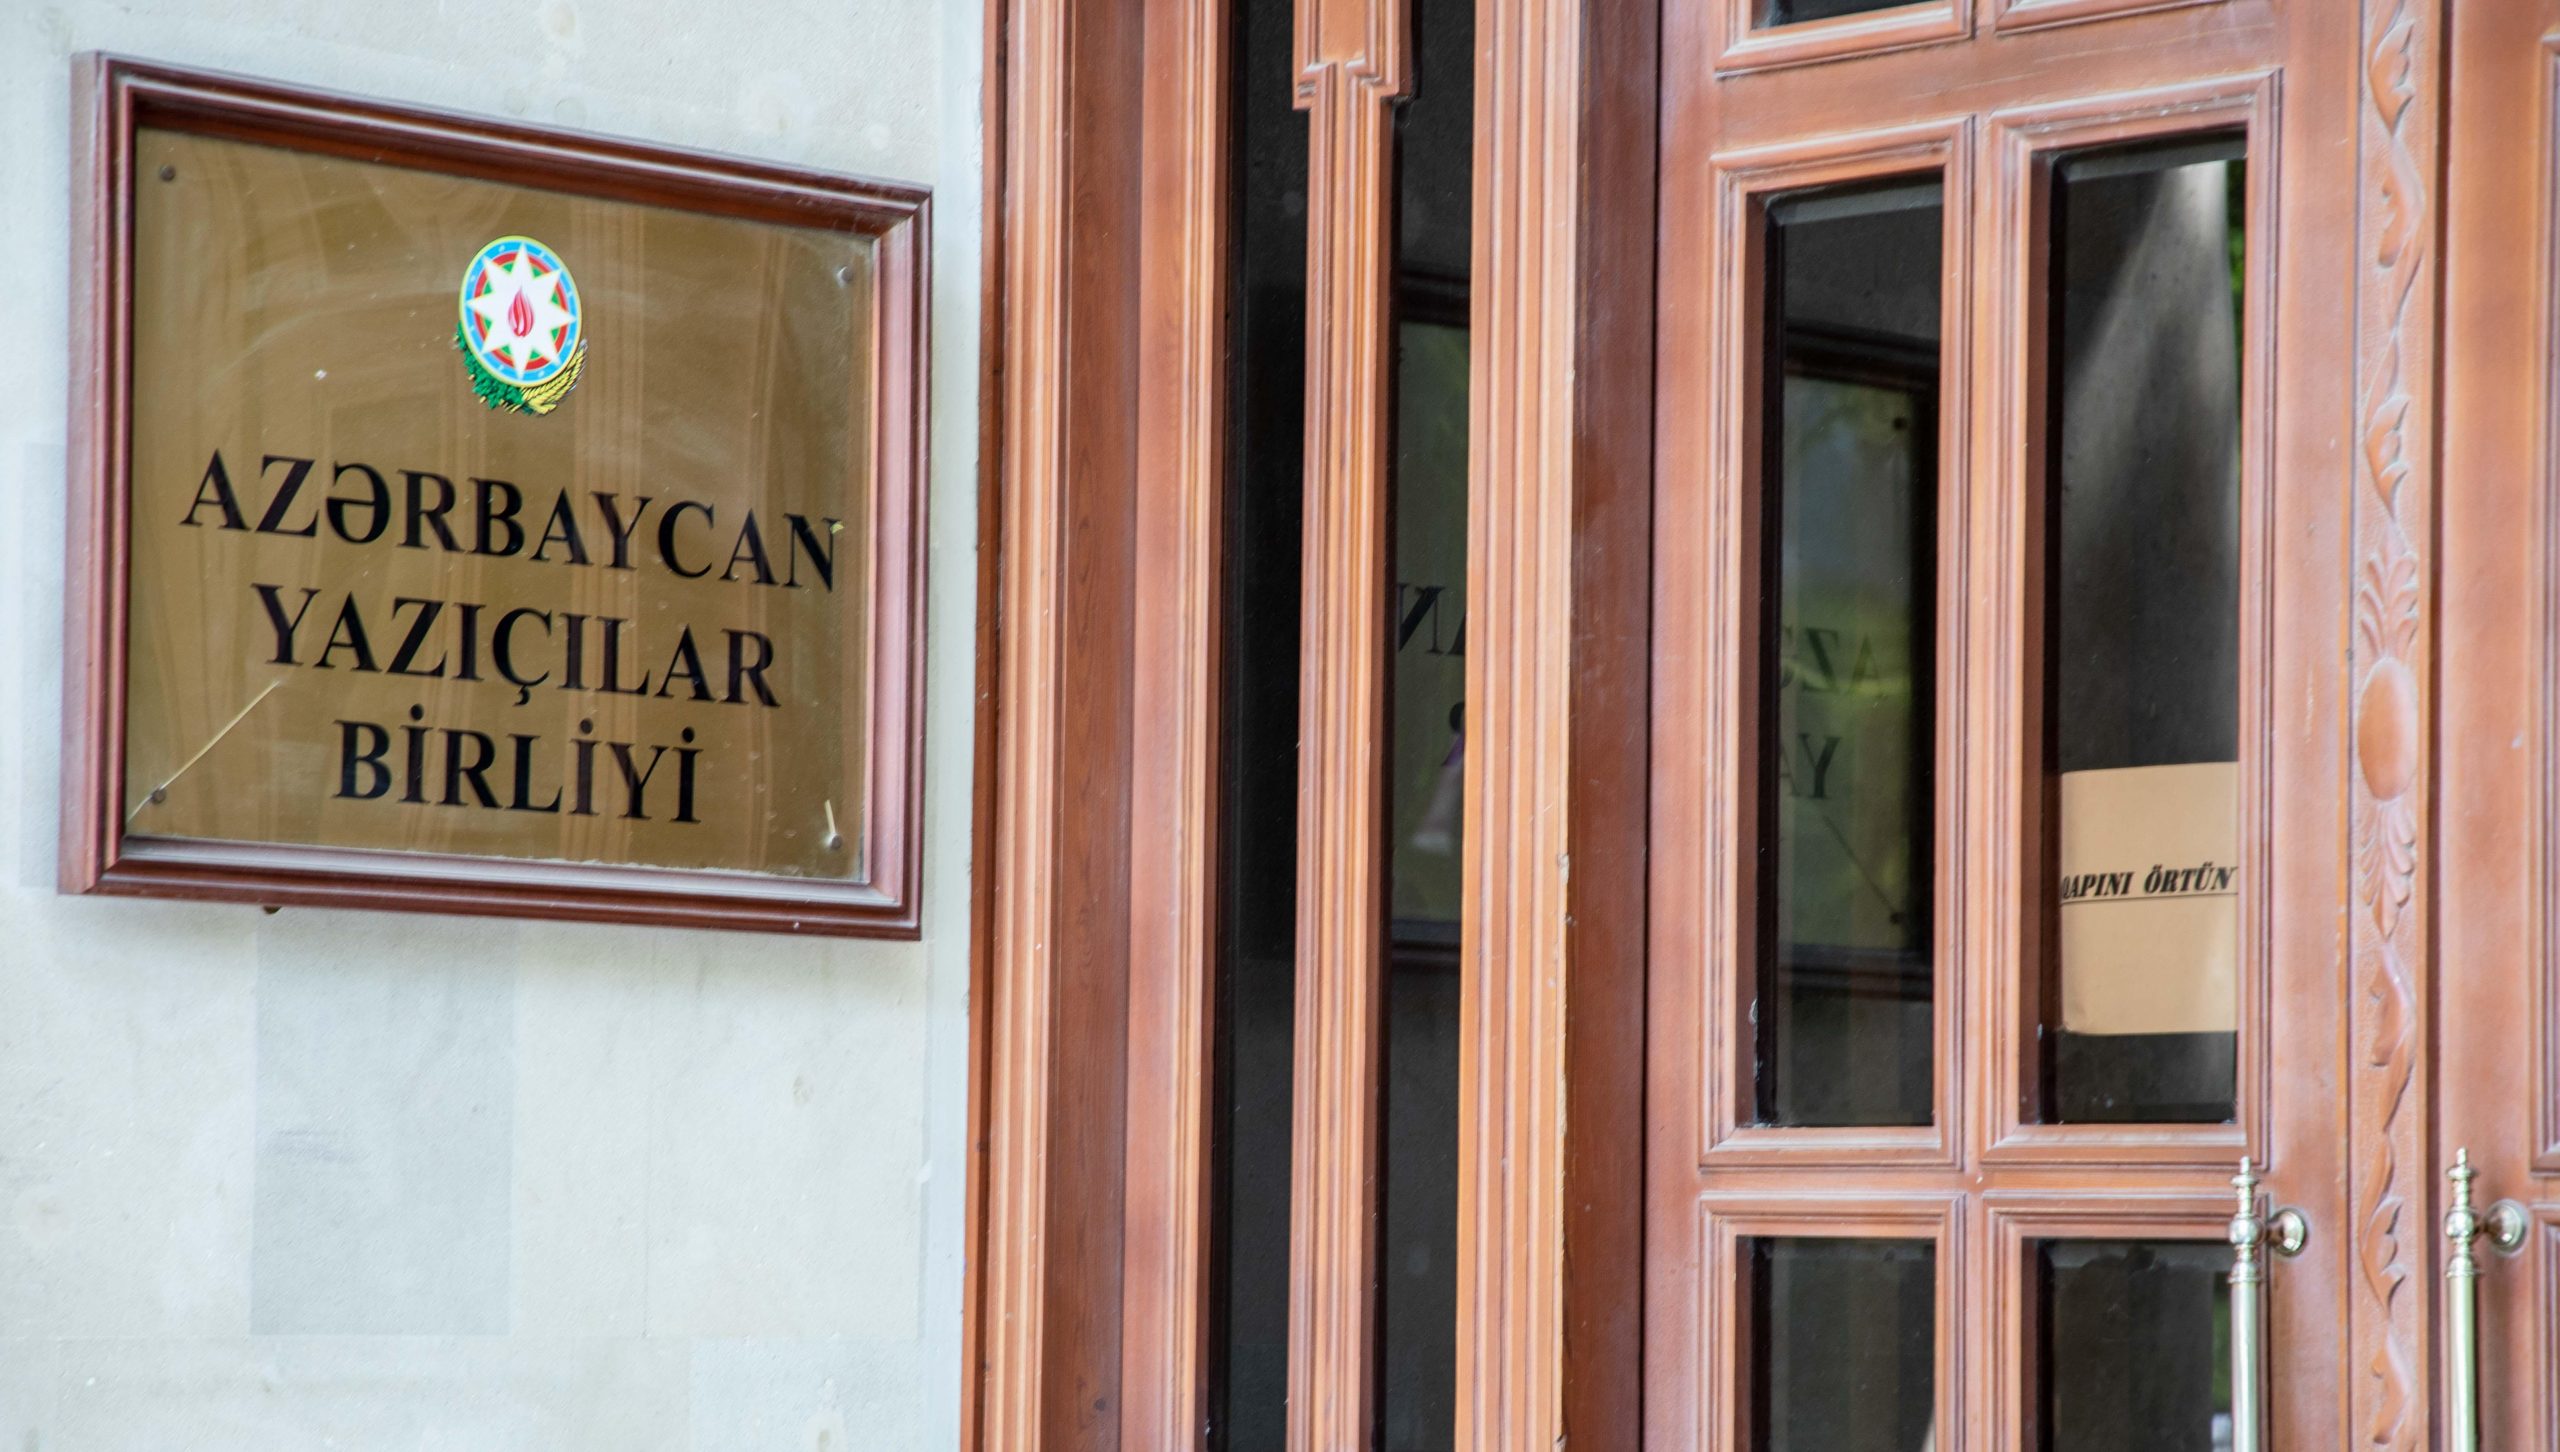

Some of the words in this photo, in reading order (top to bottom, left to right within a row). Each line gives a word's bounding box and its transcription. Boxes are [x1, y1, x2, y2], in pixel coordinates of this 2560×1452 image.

[179, 449, 842, 592] AZƏRBAYCAN
[251, 583, 781, 708] YAZIÇILAR
[333, 703, 704, 823] BİRLİYİ
[2144, 861, 2238, 893] ÖRTÜN
